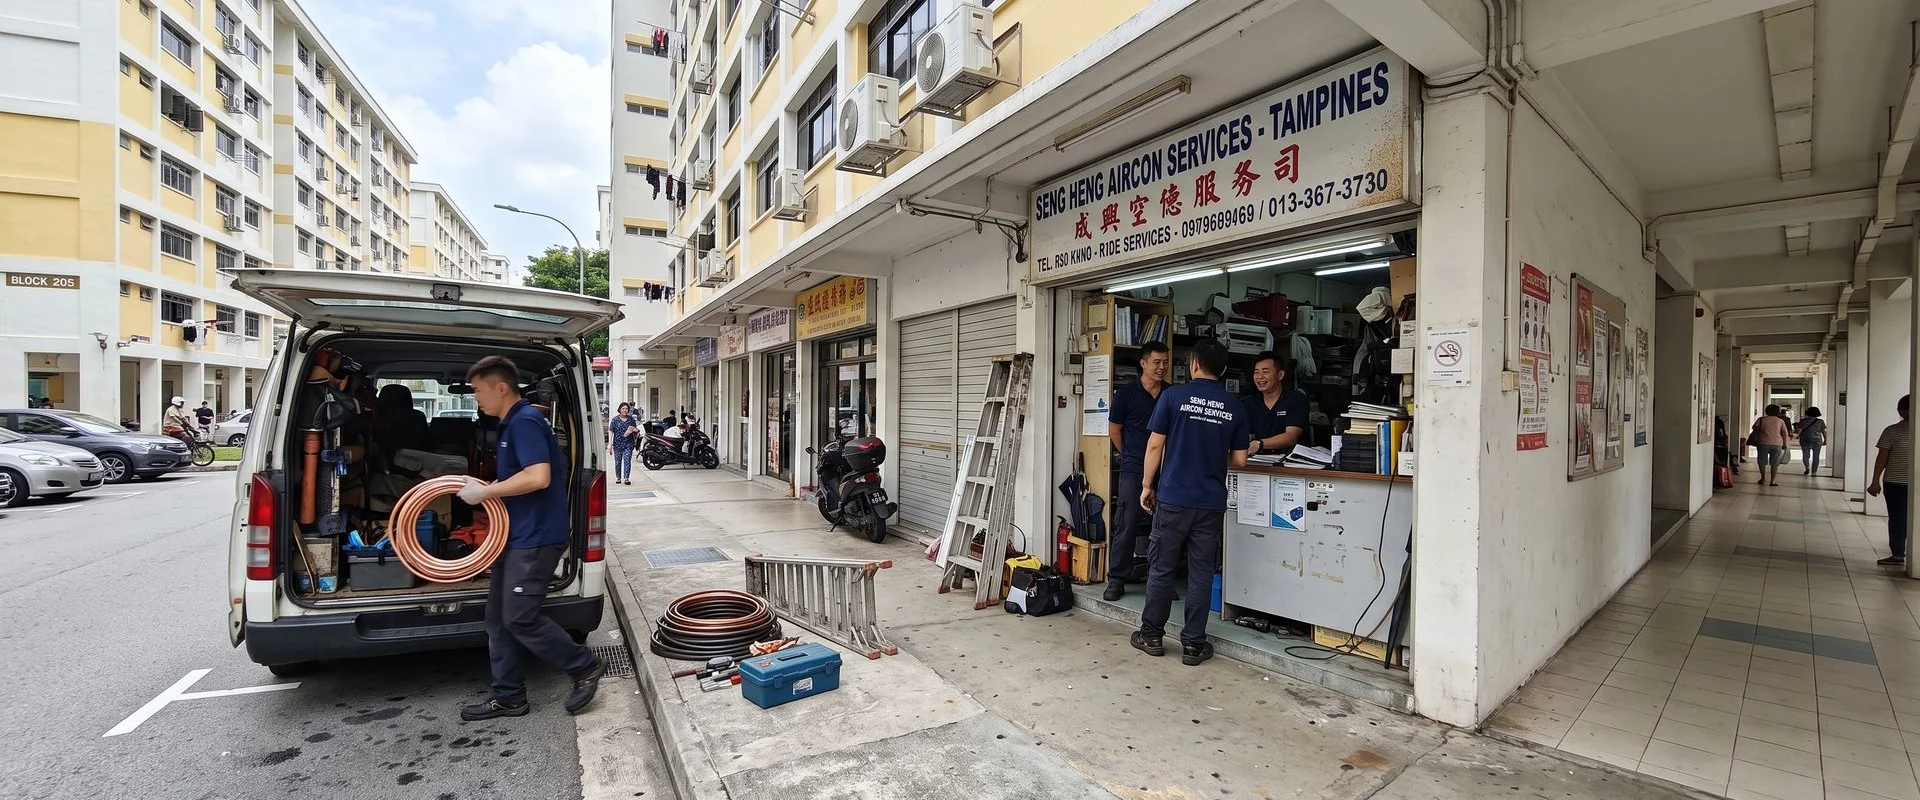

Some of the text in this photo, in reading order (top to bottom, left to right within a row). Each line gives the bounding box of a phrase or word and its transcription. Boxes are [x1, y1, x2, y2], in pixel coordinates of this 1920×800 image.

[1036, 186, 1066, 221] SENG
[1069, 173, 1104, 210] HENG
[1108, 148, 1163, 197] AIRCON
[1167, 114, 1252, 177] SERVICES
[1269, 61, 1389, 141] TAMPINES
[1037, 257, 1053, 273] TEL.
[1123, 225, 1171, 252] SERVICES
[1259, 200, 1264, 220] /
[1268, 168, 1389, 218] 013-367-3730
[11, 275, 75, 287] BLOCK 205
[1180, 404, 1203, 414] AIRCON
[1189, 396, 1224, 409] SENG HENG
